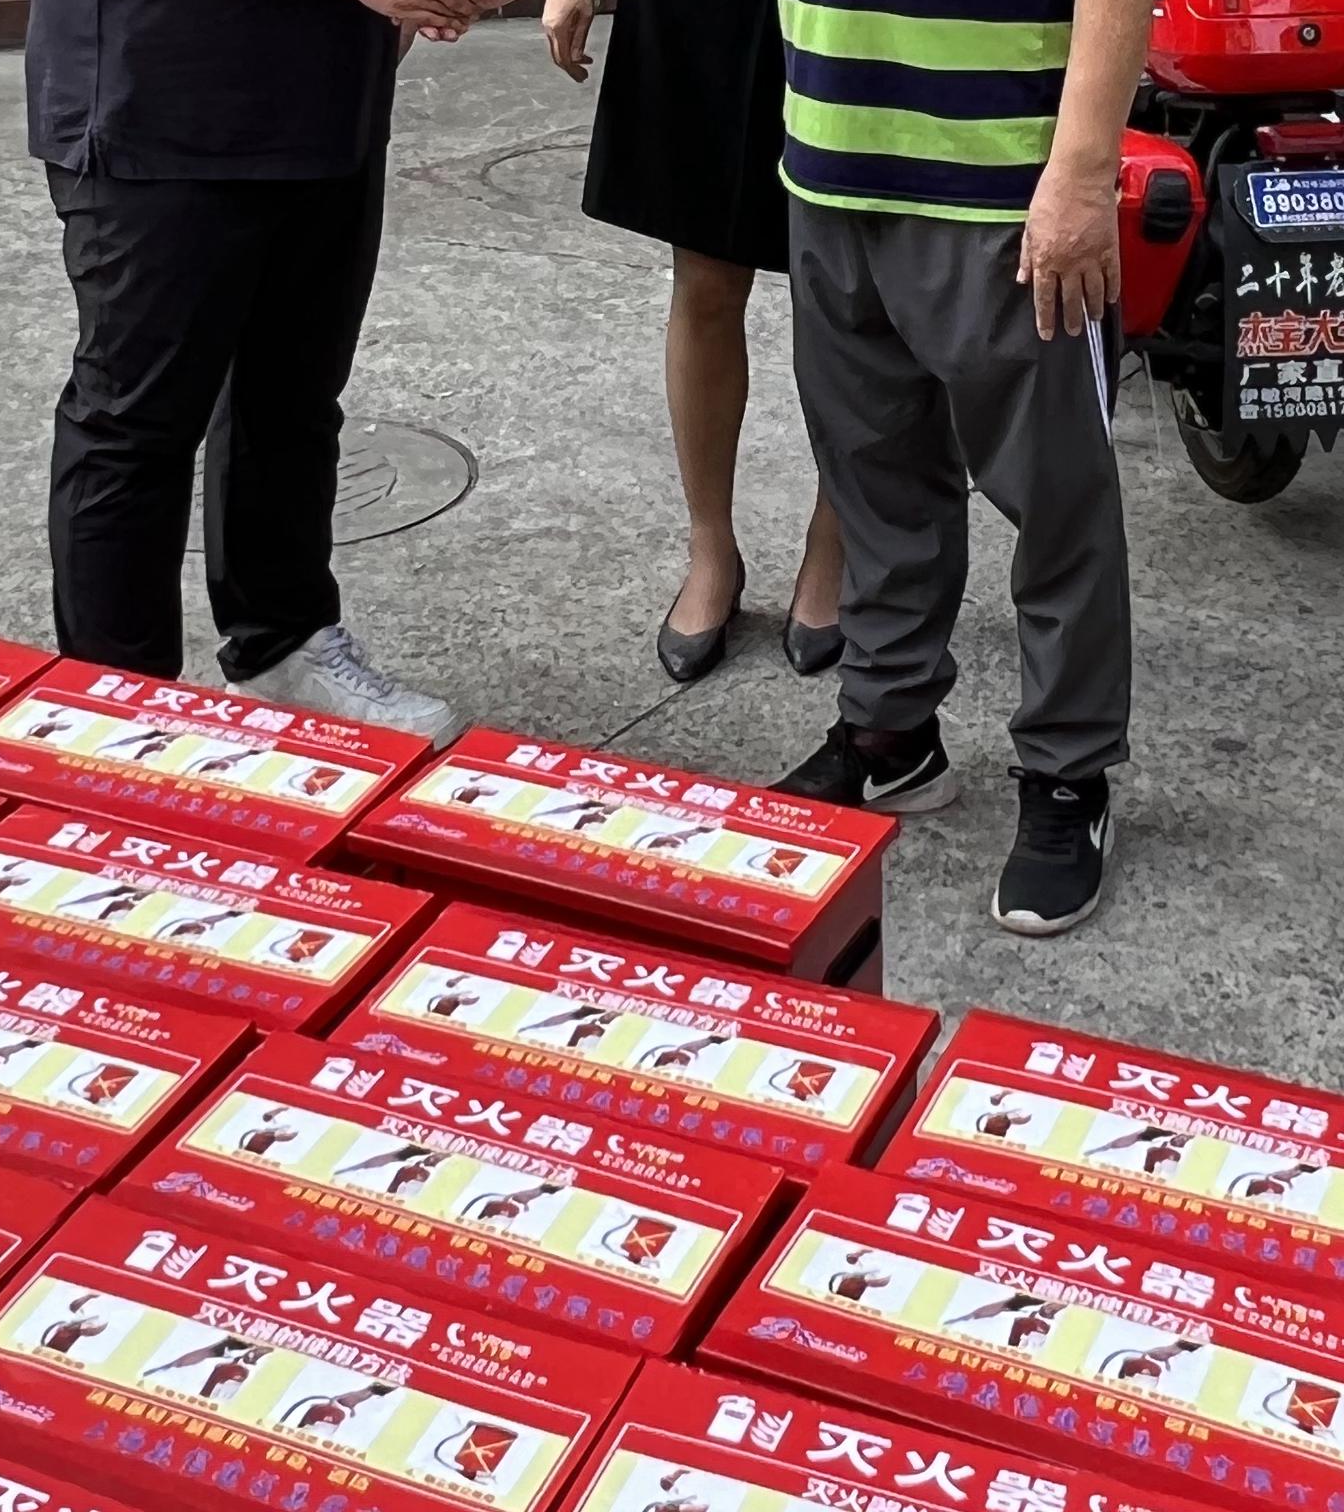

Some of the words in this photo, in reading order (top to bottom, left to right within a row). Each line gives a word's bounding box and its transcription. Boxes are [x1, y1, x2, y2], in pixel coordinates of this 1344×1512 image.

[570, 758, 737, 811] 灭火器
[109, 836, 281, 890] 灭火器
[560, 948, 752, 1010] 灭火器
[387, 1078, 594, 1155] 灭火器
[1108, 1061, 1329, 1139] 灭火器
[206, 1252, 433, 1350] 灭火器
[974, 1260, 1214, 1338] 灭火器的使用方法
[976, 1216, 1216, 1308] 灭火器
[192, 1300, 413, 1384] 灭火器的使用方法
[806, 1422, 1067, 1512] 灭火器
